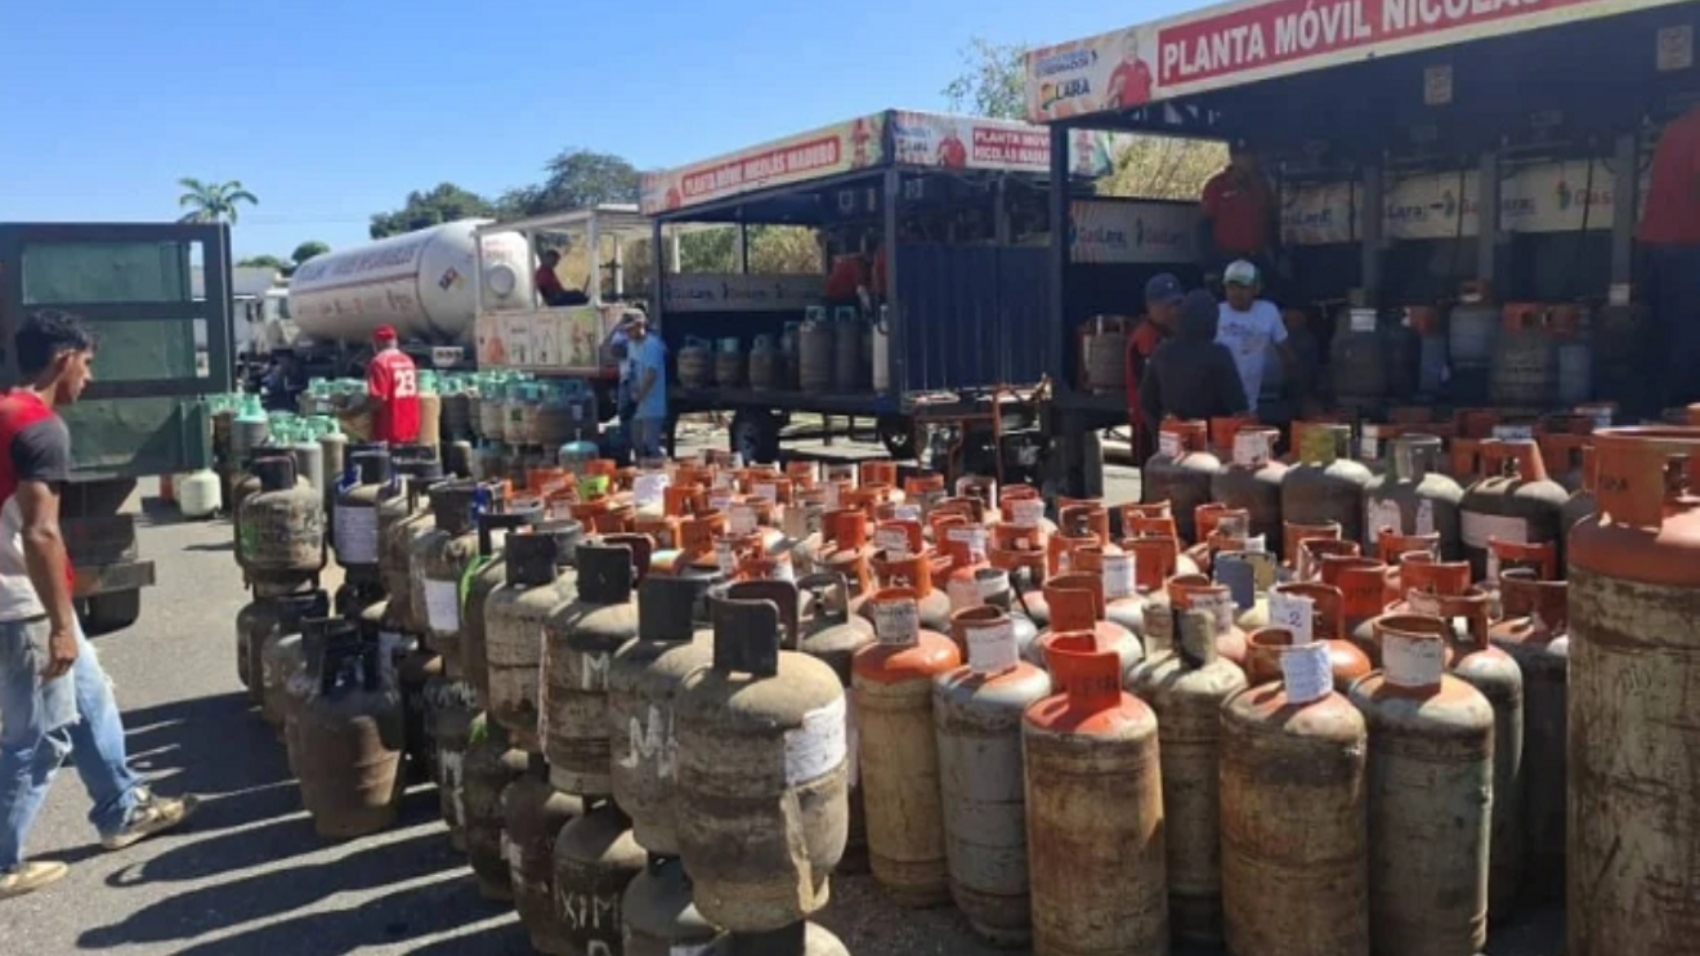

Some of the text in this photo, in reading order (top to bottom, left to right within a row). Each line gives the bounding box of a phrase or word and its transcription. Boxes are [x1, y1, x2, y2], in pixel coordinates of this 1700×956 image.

[1163, 26, 1265, 80] PLANTA
[1273, 0, 1373, 55] MÓVIL
[1056, 78, 1090, 99] LARA
[975, 130, 1019, 145] PLANTA
[1020, 147, 1049, 162] MADU
[394, 369, 416, 398] 23
